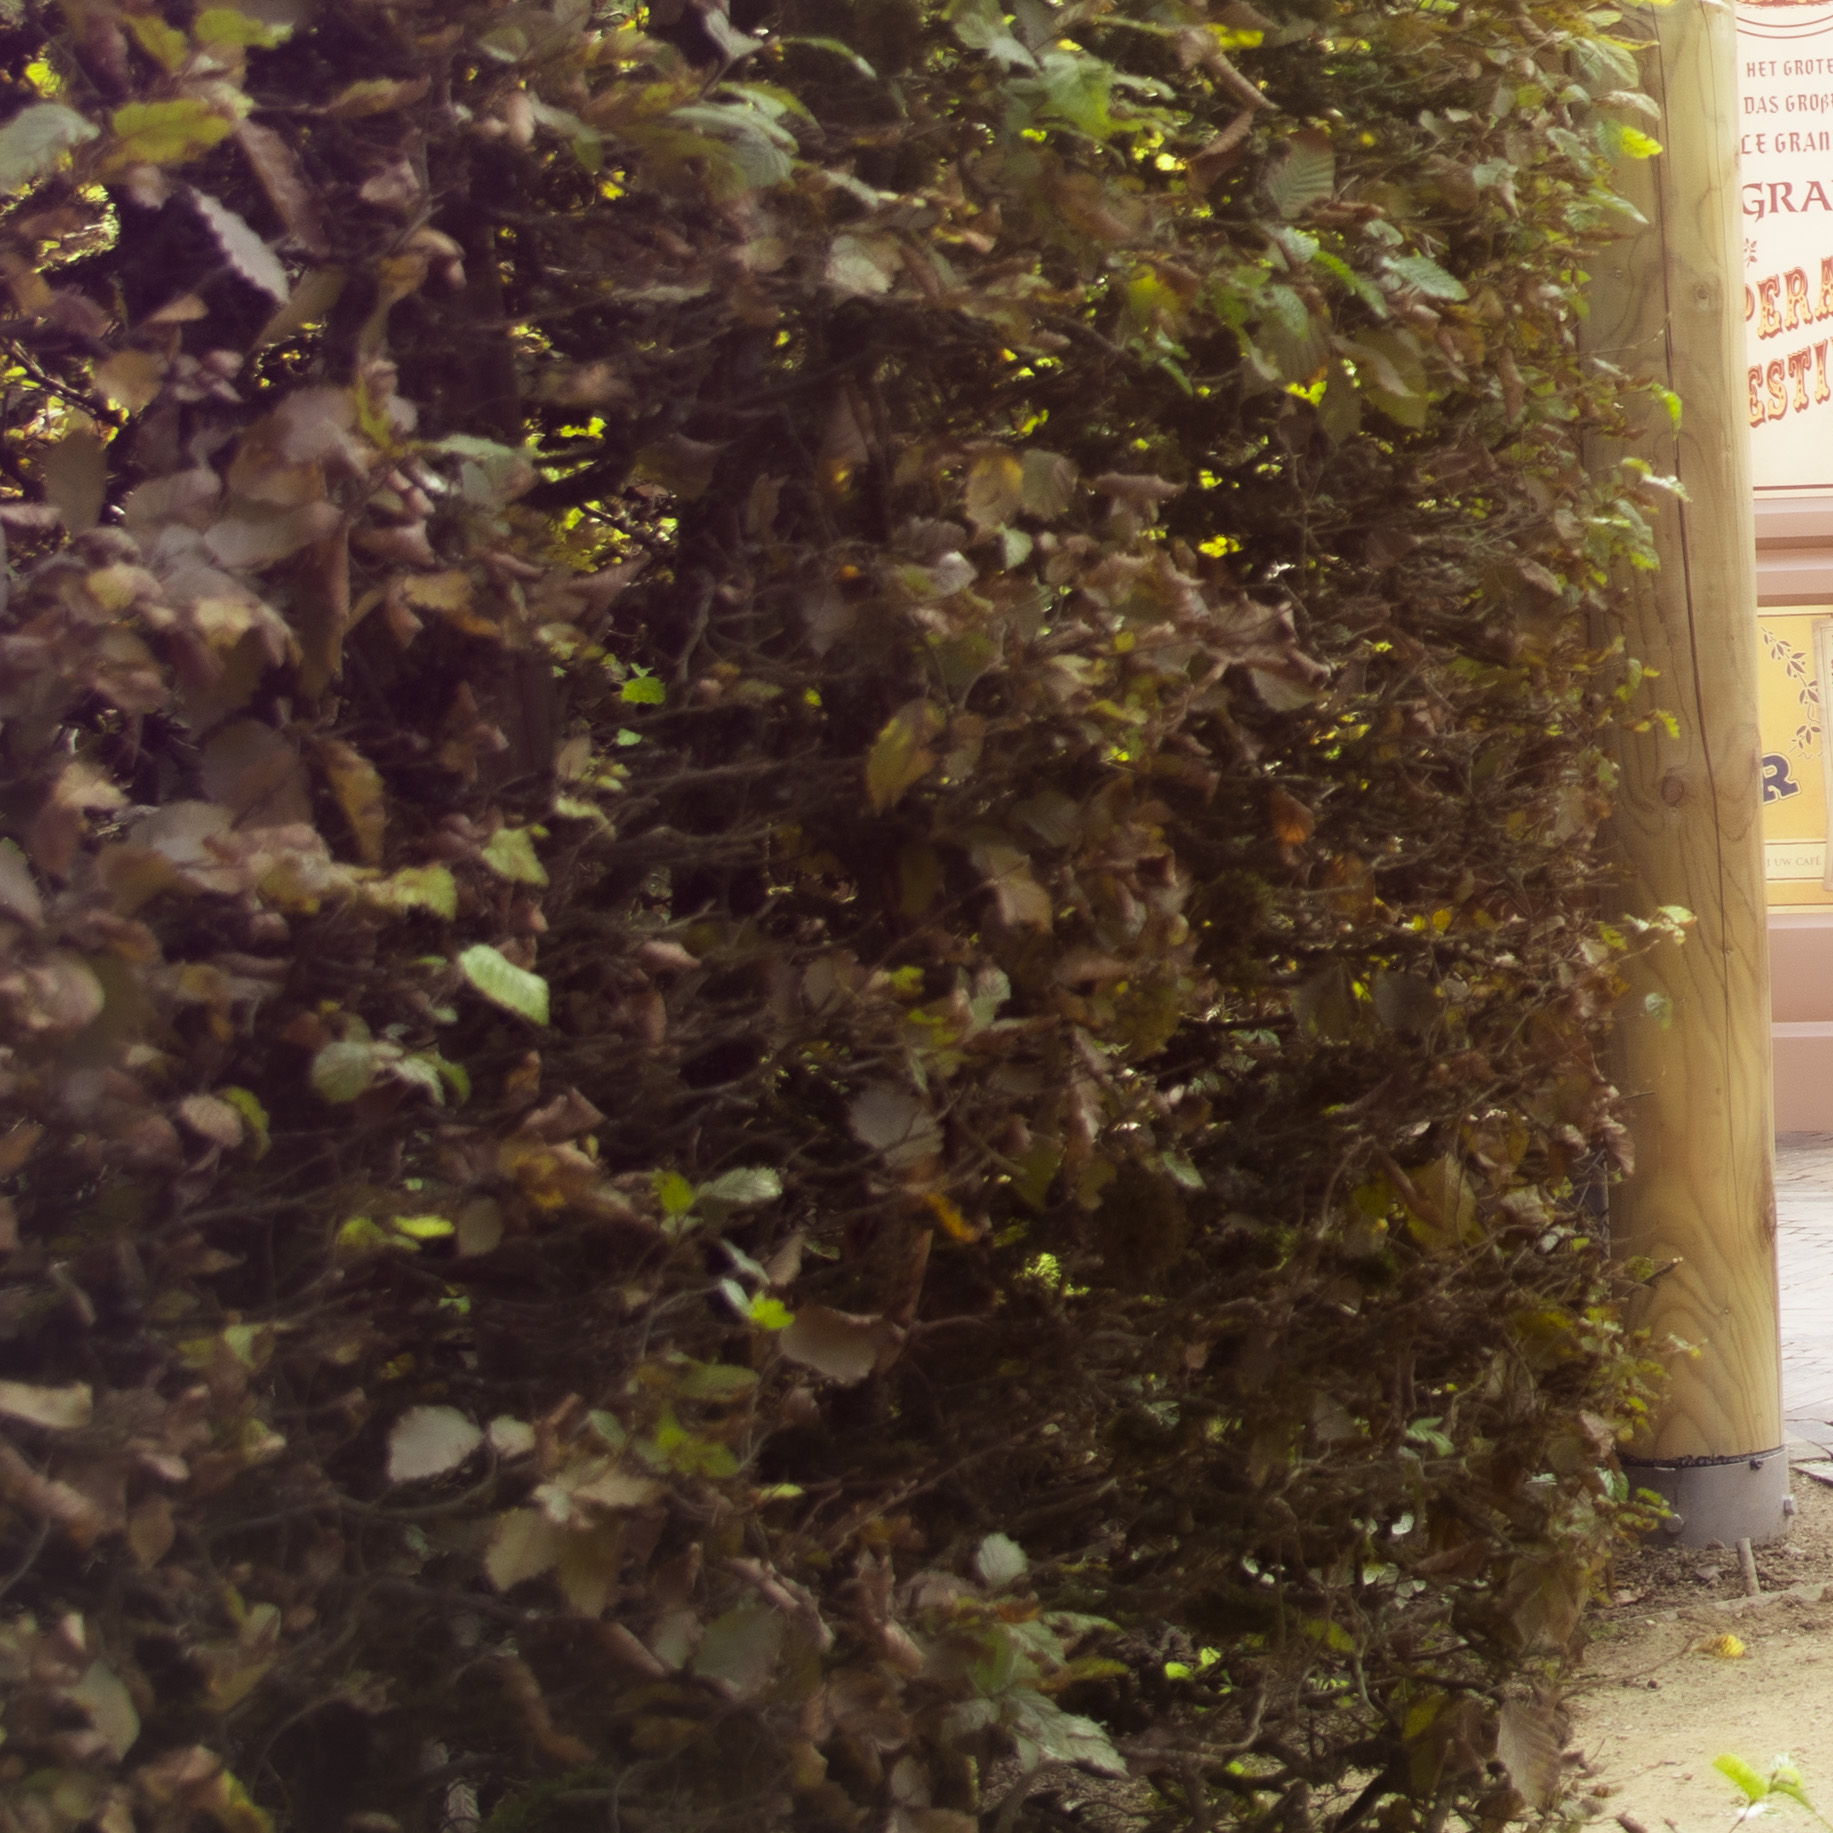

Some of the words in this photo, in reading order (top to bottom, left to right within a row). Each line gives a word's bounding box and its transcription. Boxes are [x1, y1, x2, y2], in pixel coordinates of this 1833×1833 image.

[1747, 60, 1777, 78] HET
[1744, 95, 1779, 115] DAS
[1741, 133, 1767, 154] LE
[1774, 858, 1792, 867] UW
